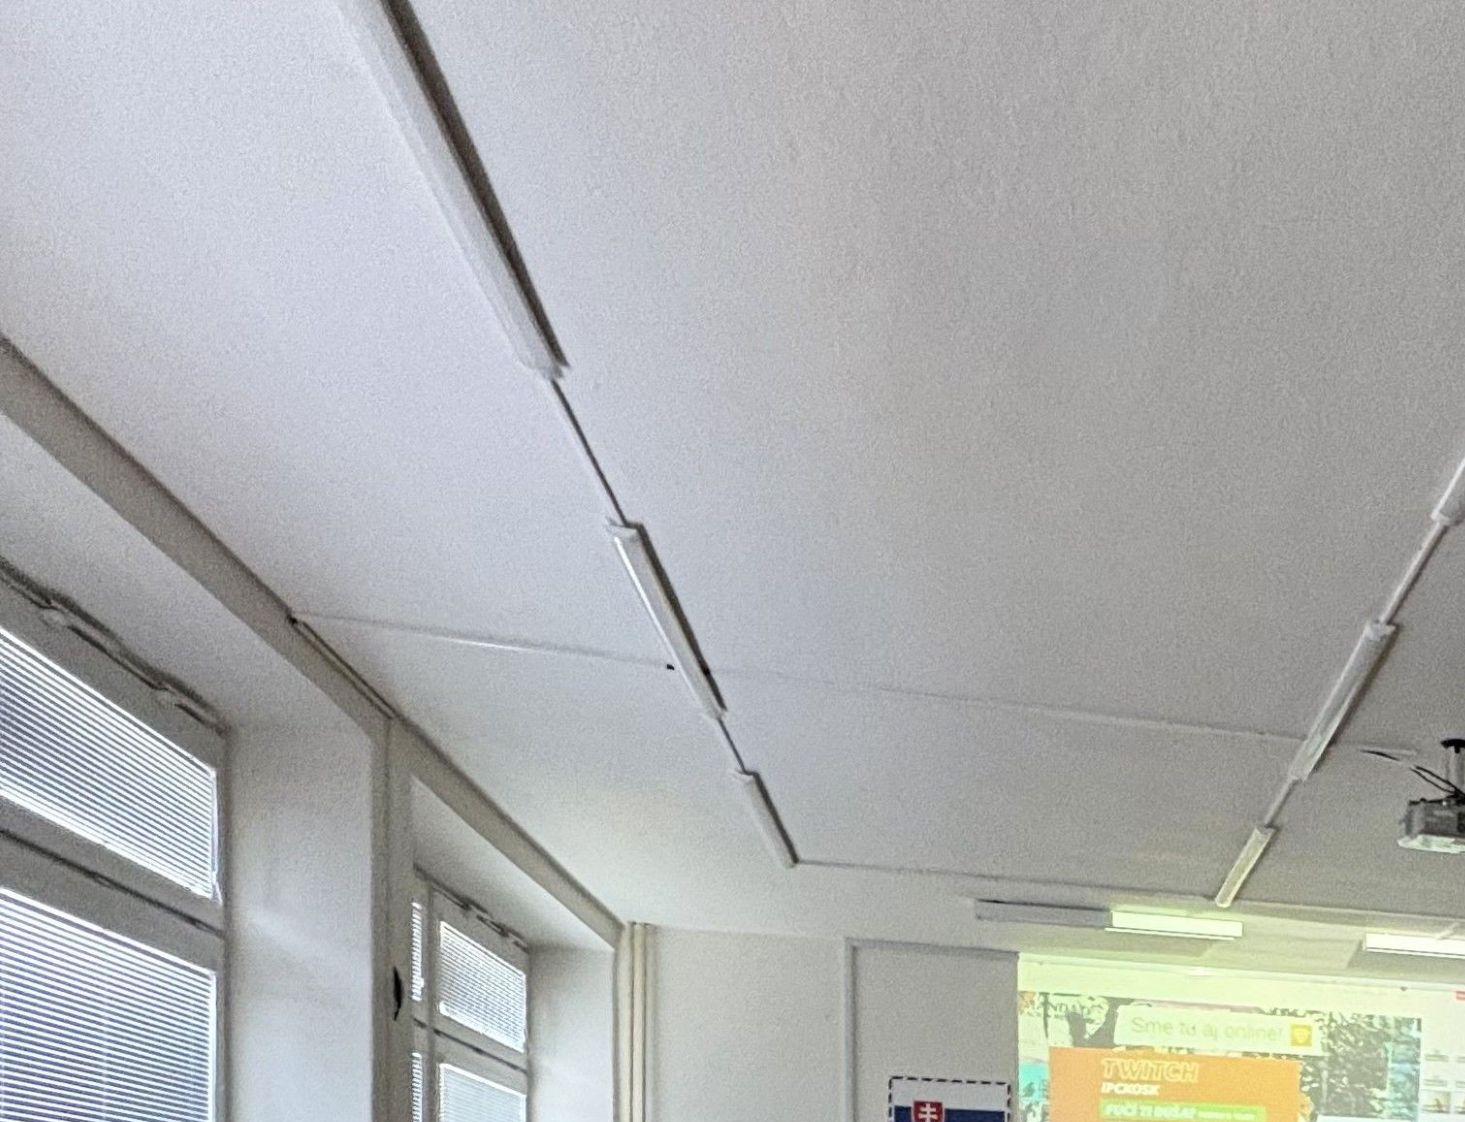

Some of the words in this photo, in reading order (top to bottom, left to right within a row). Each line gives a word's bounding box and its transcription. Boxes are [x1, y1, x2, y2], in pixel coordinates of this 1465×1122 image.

[1131, 1016, 1173, 1035] Sme
[1200, 1022, 1218, 1041] aj
[1101, 1057, 1199, 1083] TWITCH
